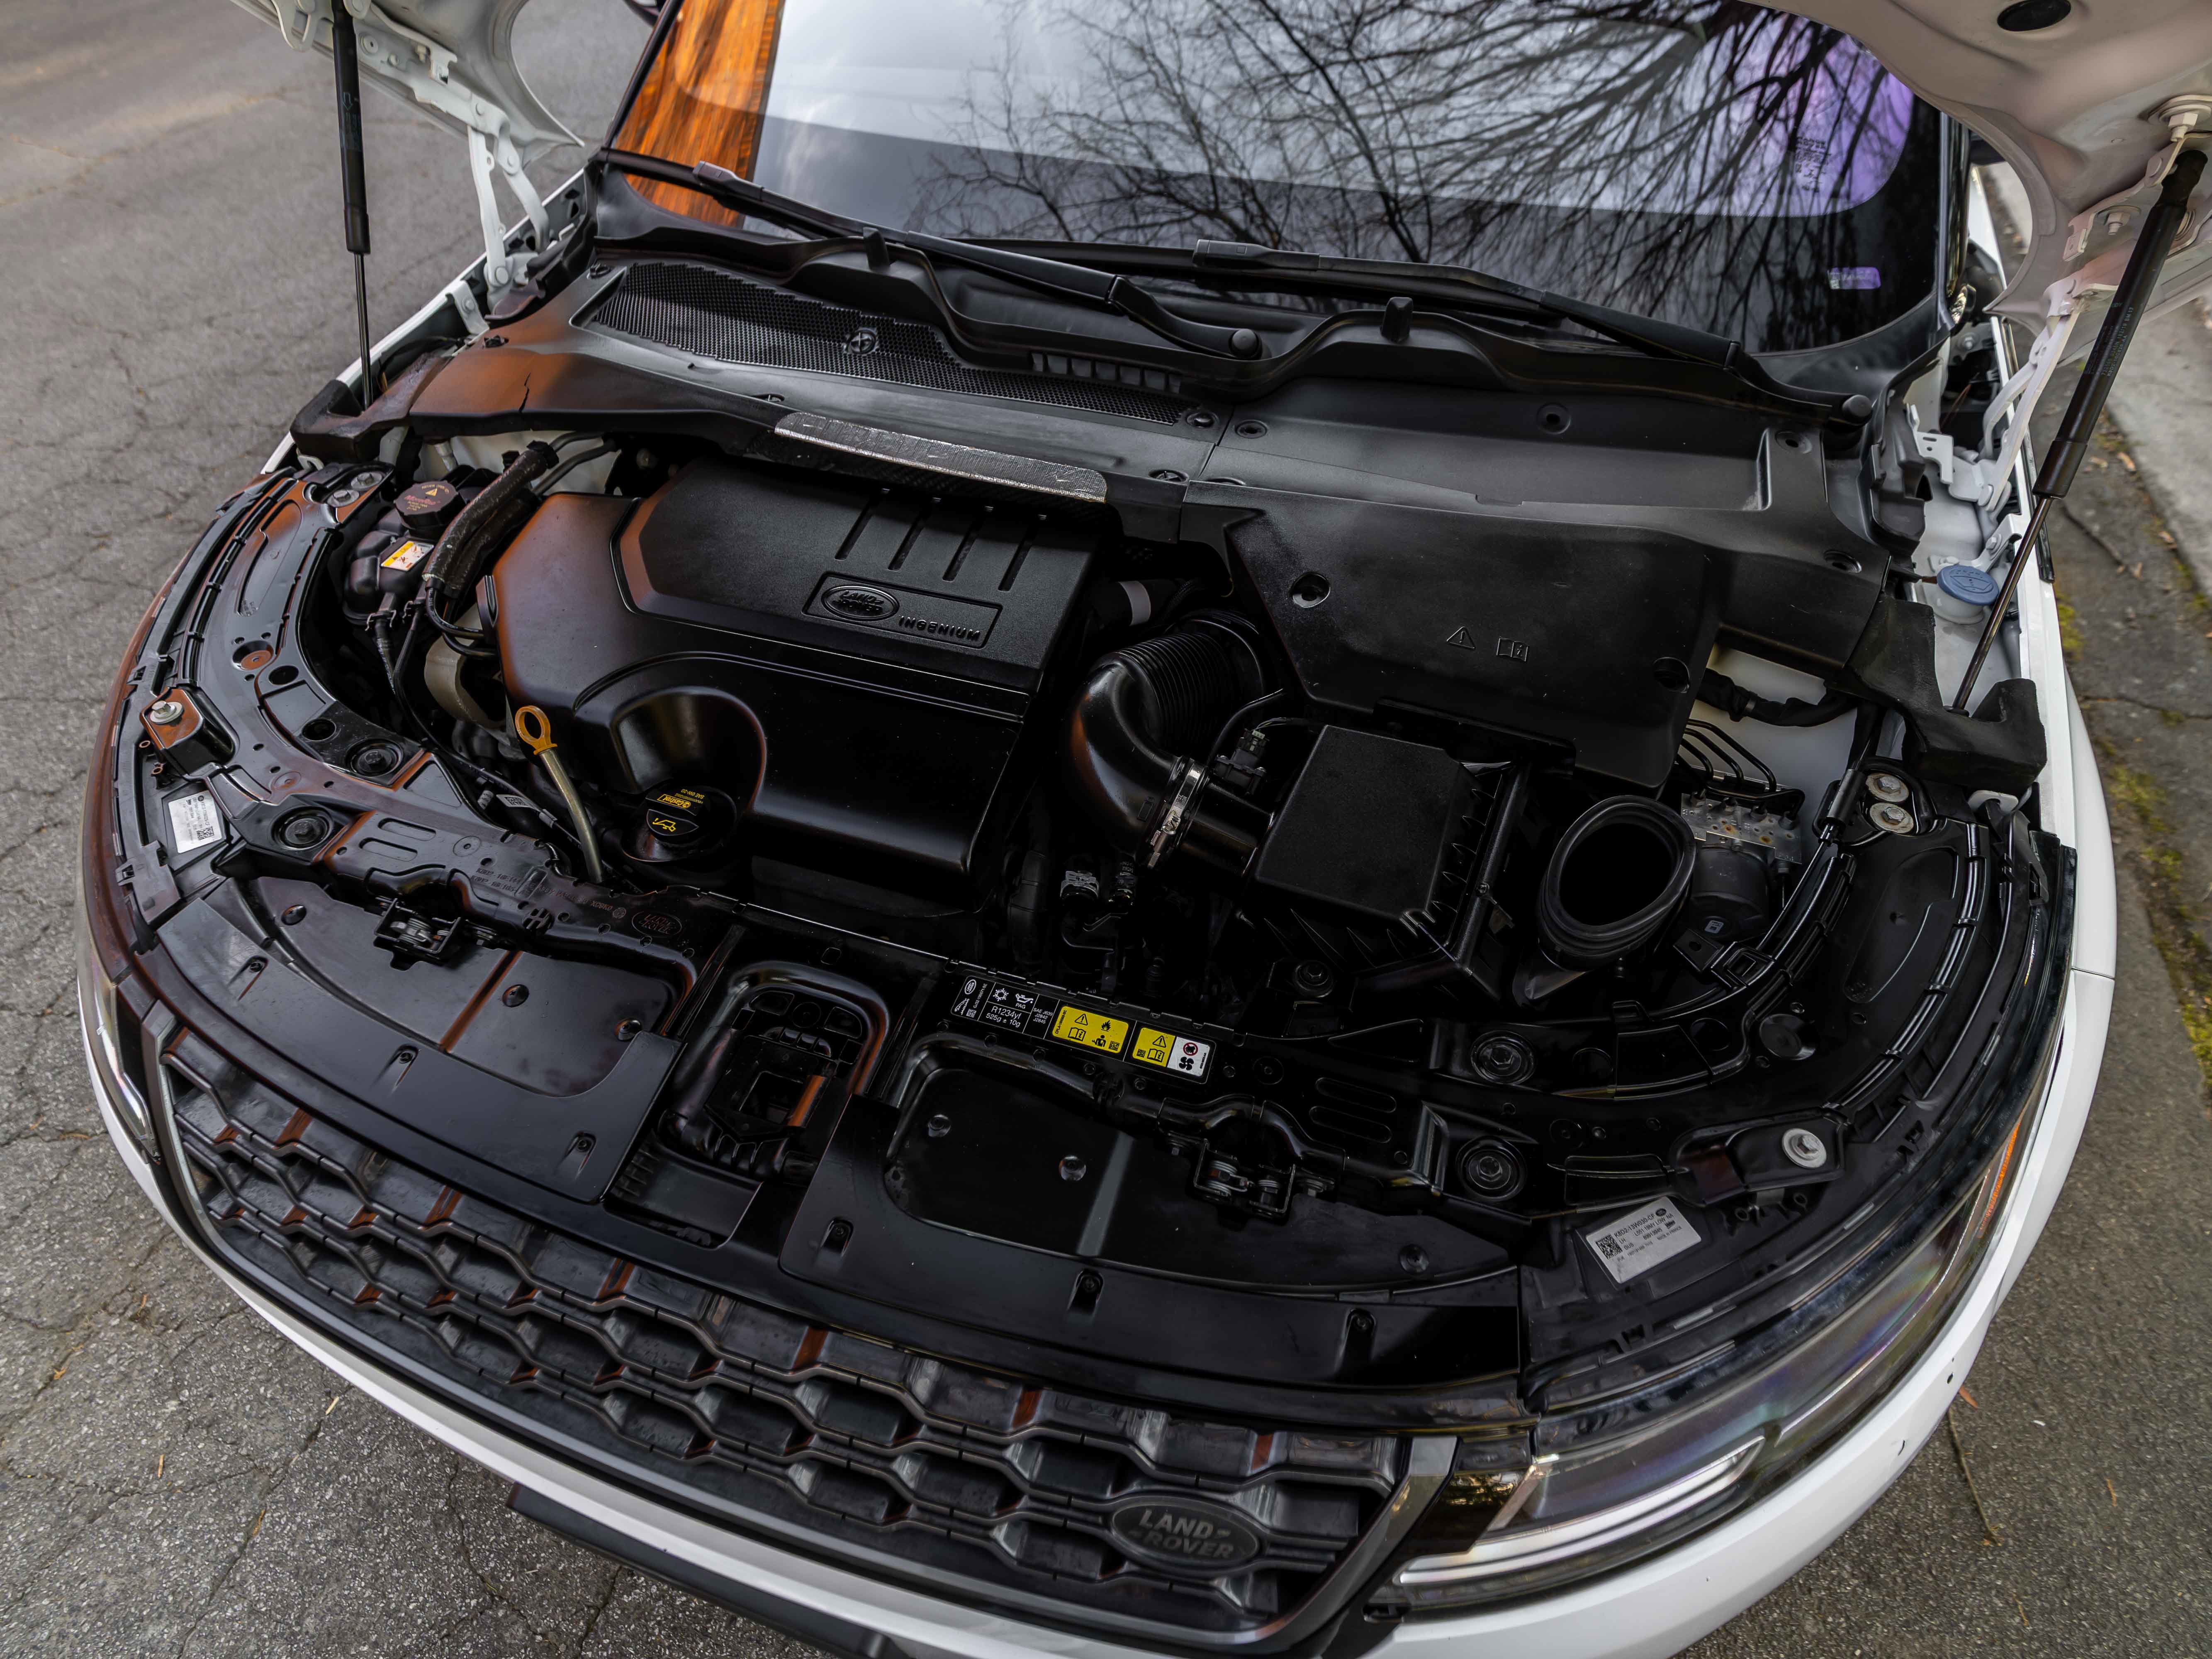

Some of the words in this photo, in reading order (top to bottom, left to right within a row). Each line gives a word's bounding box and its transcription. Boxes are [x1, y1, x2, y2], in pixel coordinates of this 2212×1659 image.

[839, 590, 878, 601] LAND
[898, 615, 981, 640] INGENIUM
[662, 796, 684, 806] Castrol
[961, 998, 970, 1015] JAGUAR
[991, 1006, 1022, 1019] R1234yf
[986, 1013, 1002, 1022] 525g
[1009, 1019, 1021, 1028] 10g
[1655, 1217, 1666, 1226] LOW
[1139, 1508, 1214, 1539] LAND
[1143, 1530, 1234, 1558] ROVER
